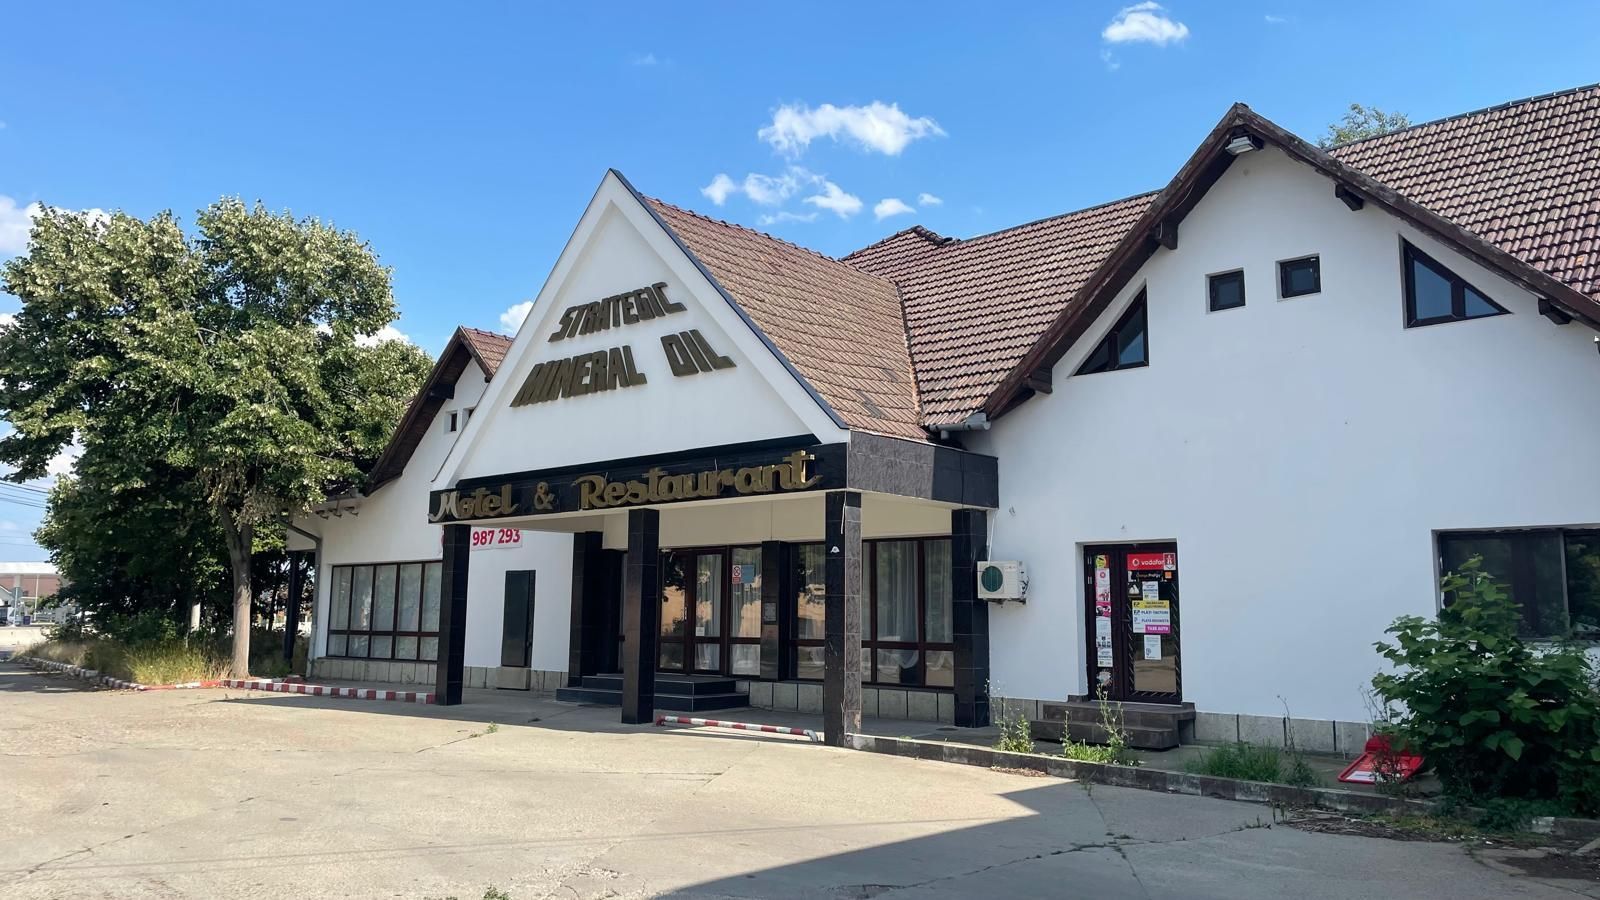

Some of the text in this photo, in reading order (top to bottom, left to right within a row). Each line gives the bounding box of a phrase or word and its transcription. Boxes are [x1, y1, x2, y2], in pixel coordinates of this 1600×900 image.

[548, 281, 687, 342] STRATEGIC
[510, 329, 737, 407] MINERAL OIL
[428, 450, 823, 521] Motel & Restaurant
[472, 528, 520, 546] 987 293
